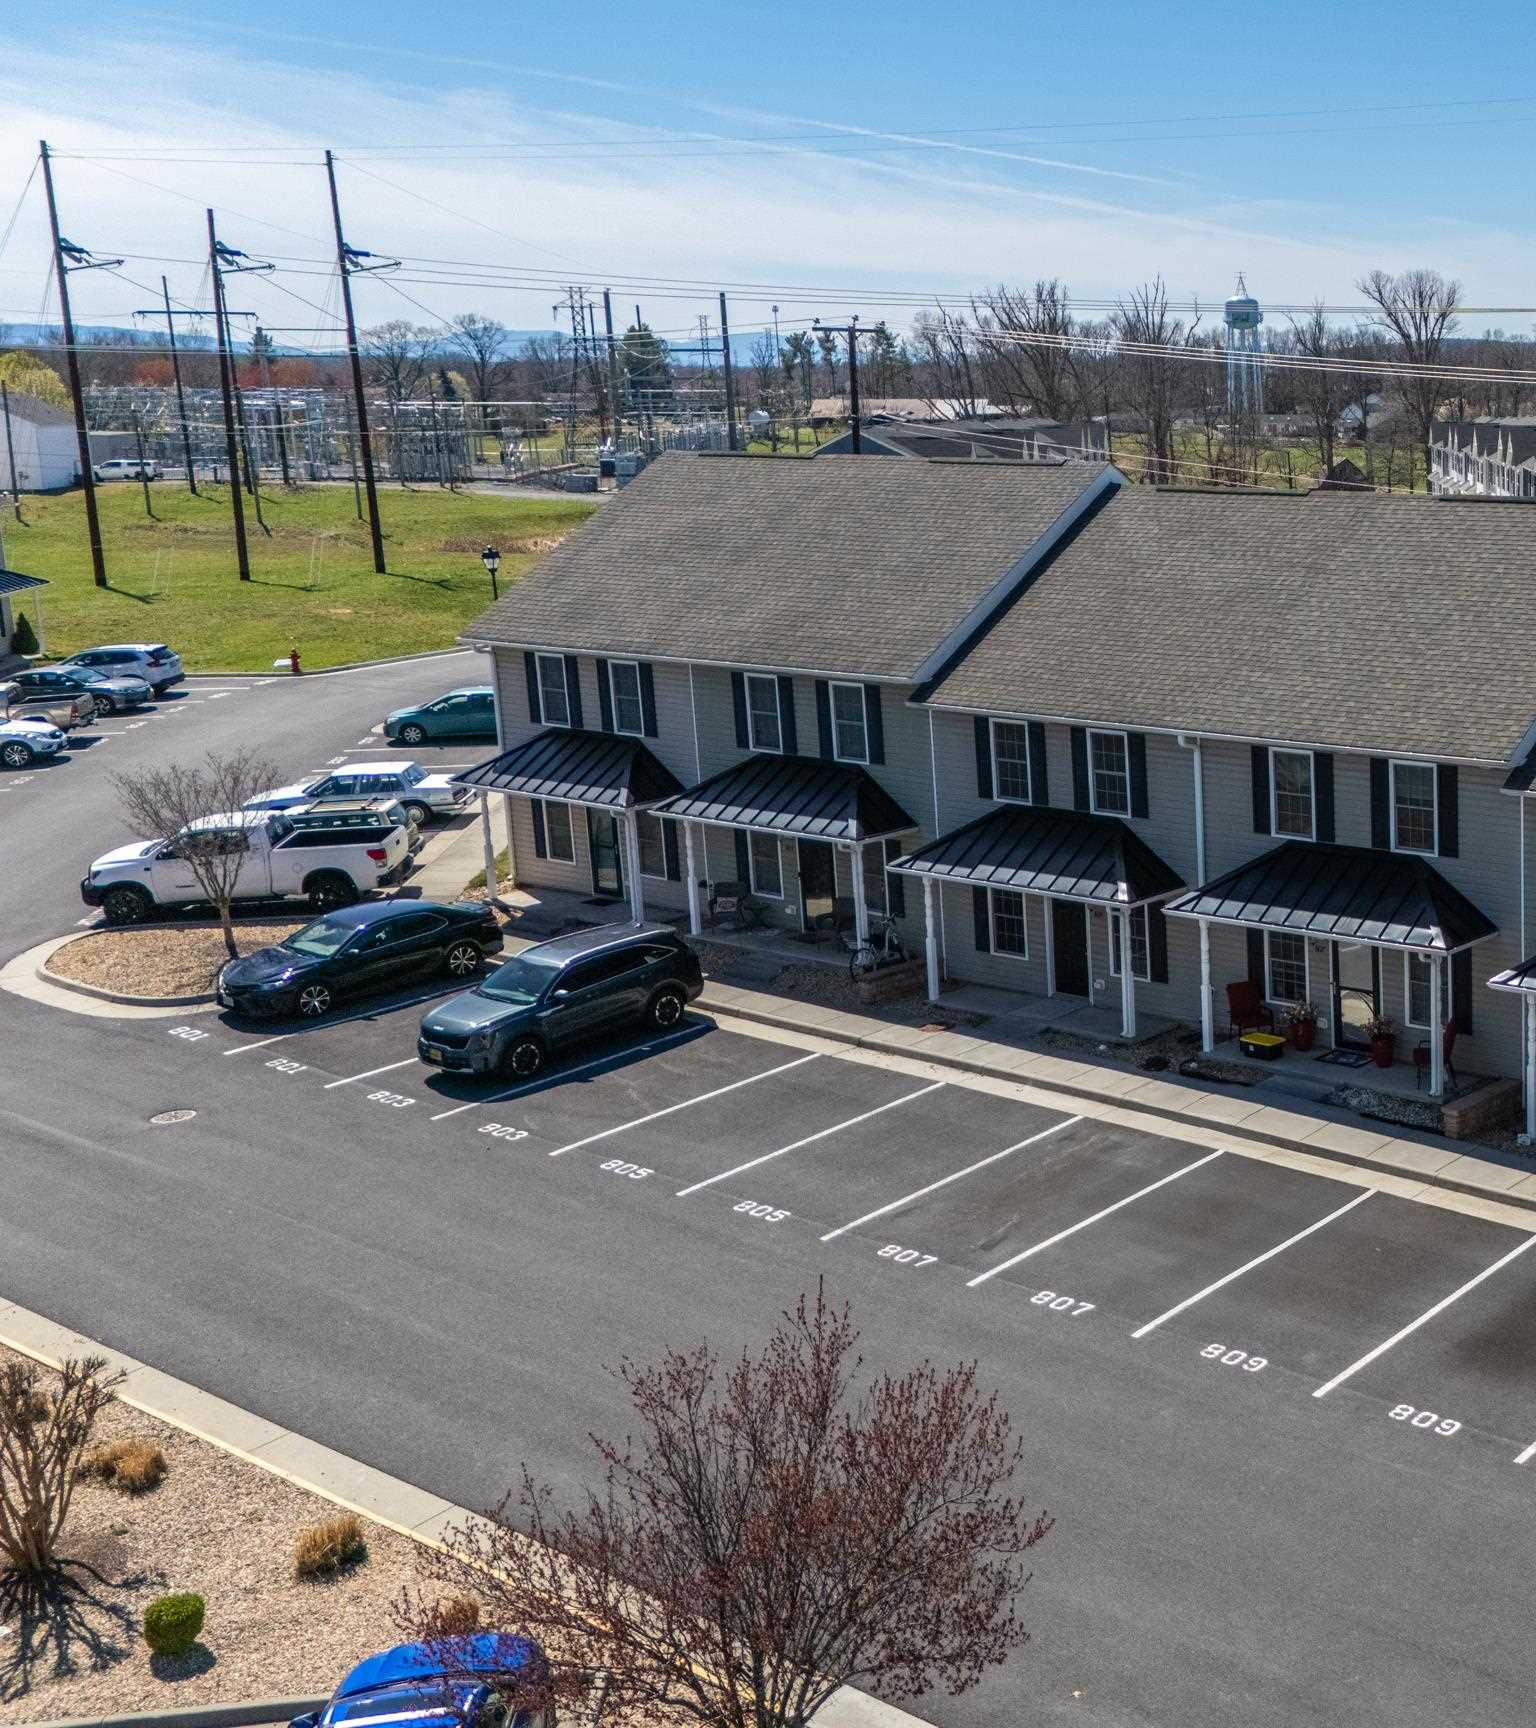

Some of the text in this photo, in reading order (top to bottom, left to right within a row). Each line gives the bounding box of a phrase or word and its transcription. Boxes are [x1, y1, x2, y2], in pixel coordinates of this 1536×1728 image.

[366, 1090, 417, 1108] 803
[477, 1123, 529, 1141] 803
[599, 1159, 655, 1179] 805
[732, 1199, 791, 1222] 805
[876, 1244, 939, 1267] 807
[1030, 1290, 1096, 1316] 807
[1199, 1343, 1269, 1372] 809
[1388, 1404, 1462, 1436] 809
